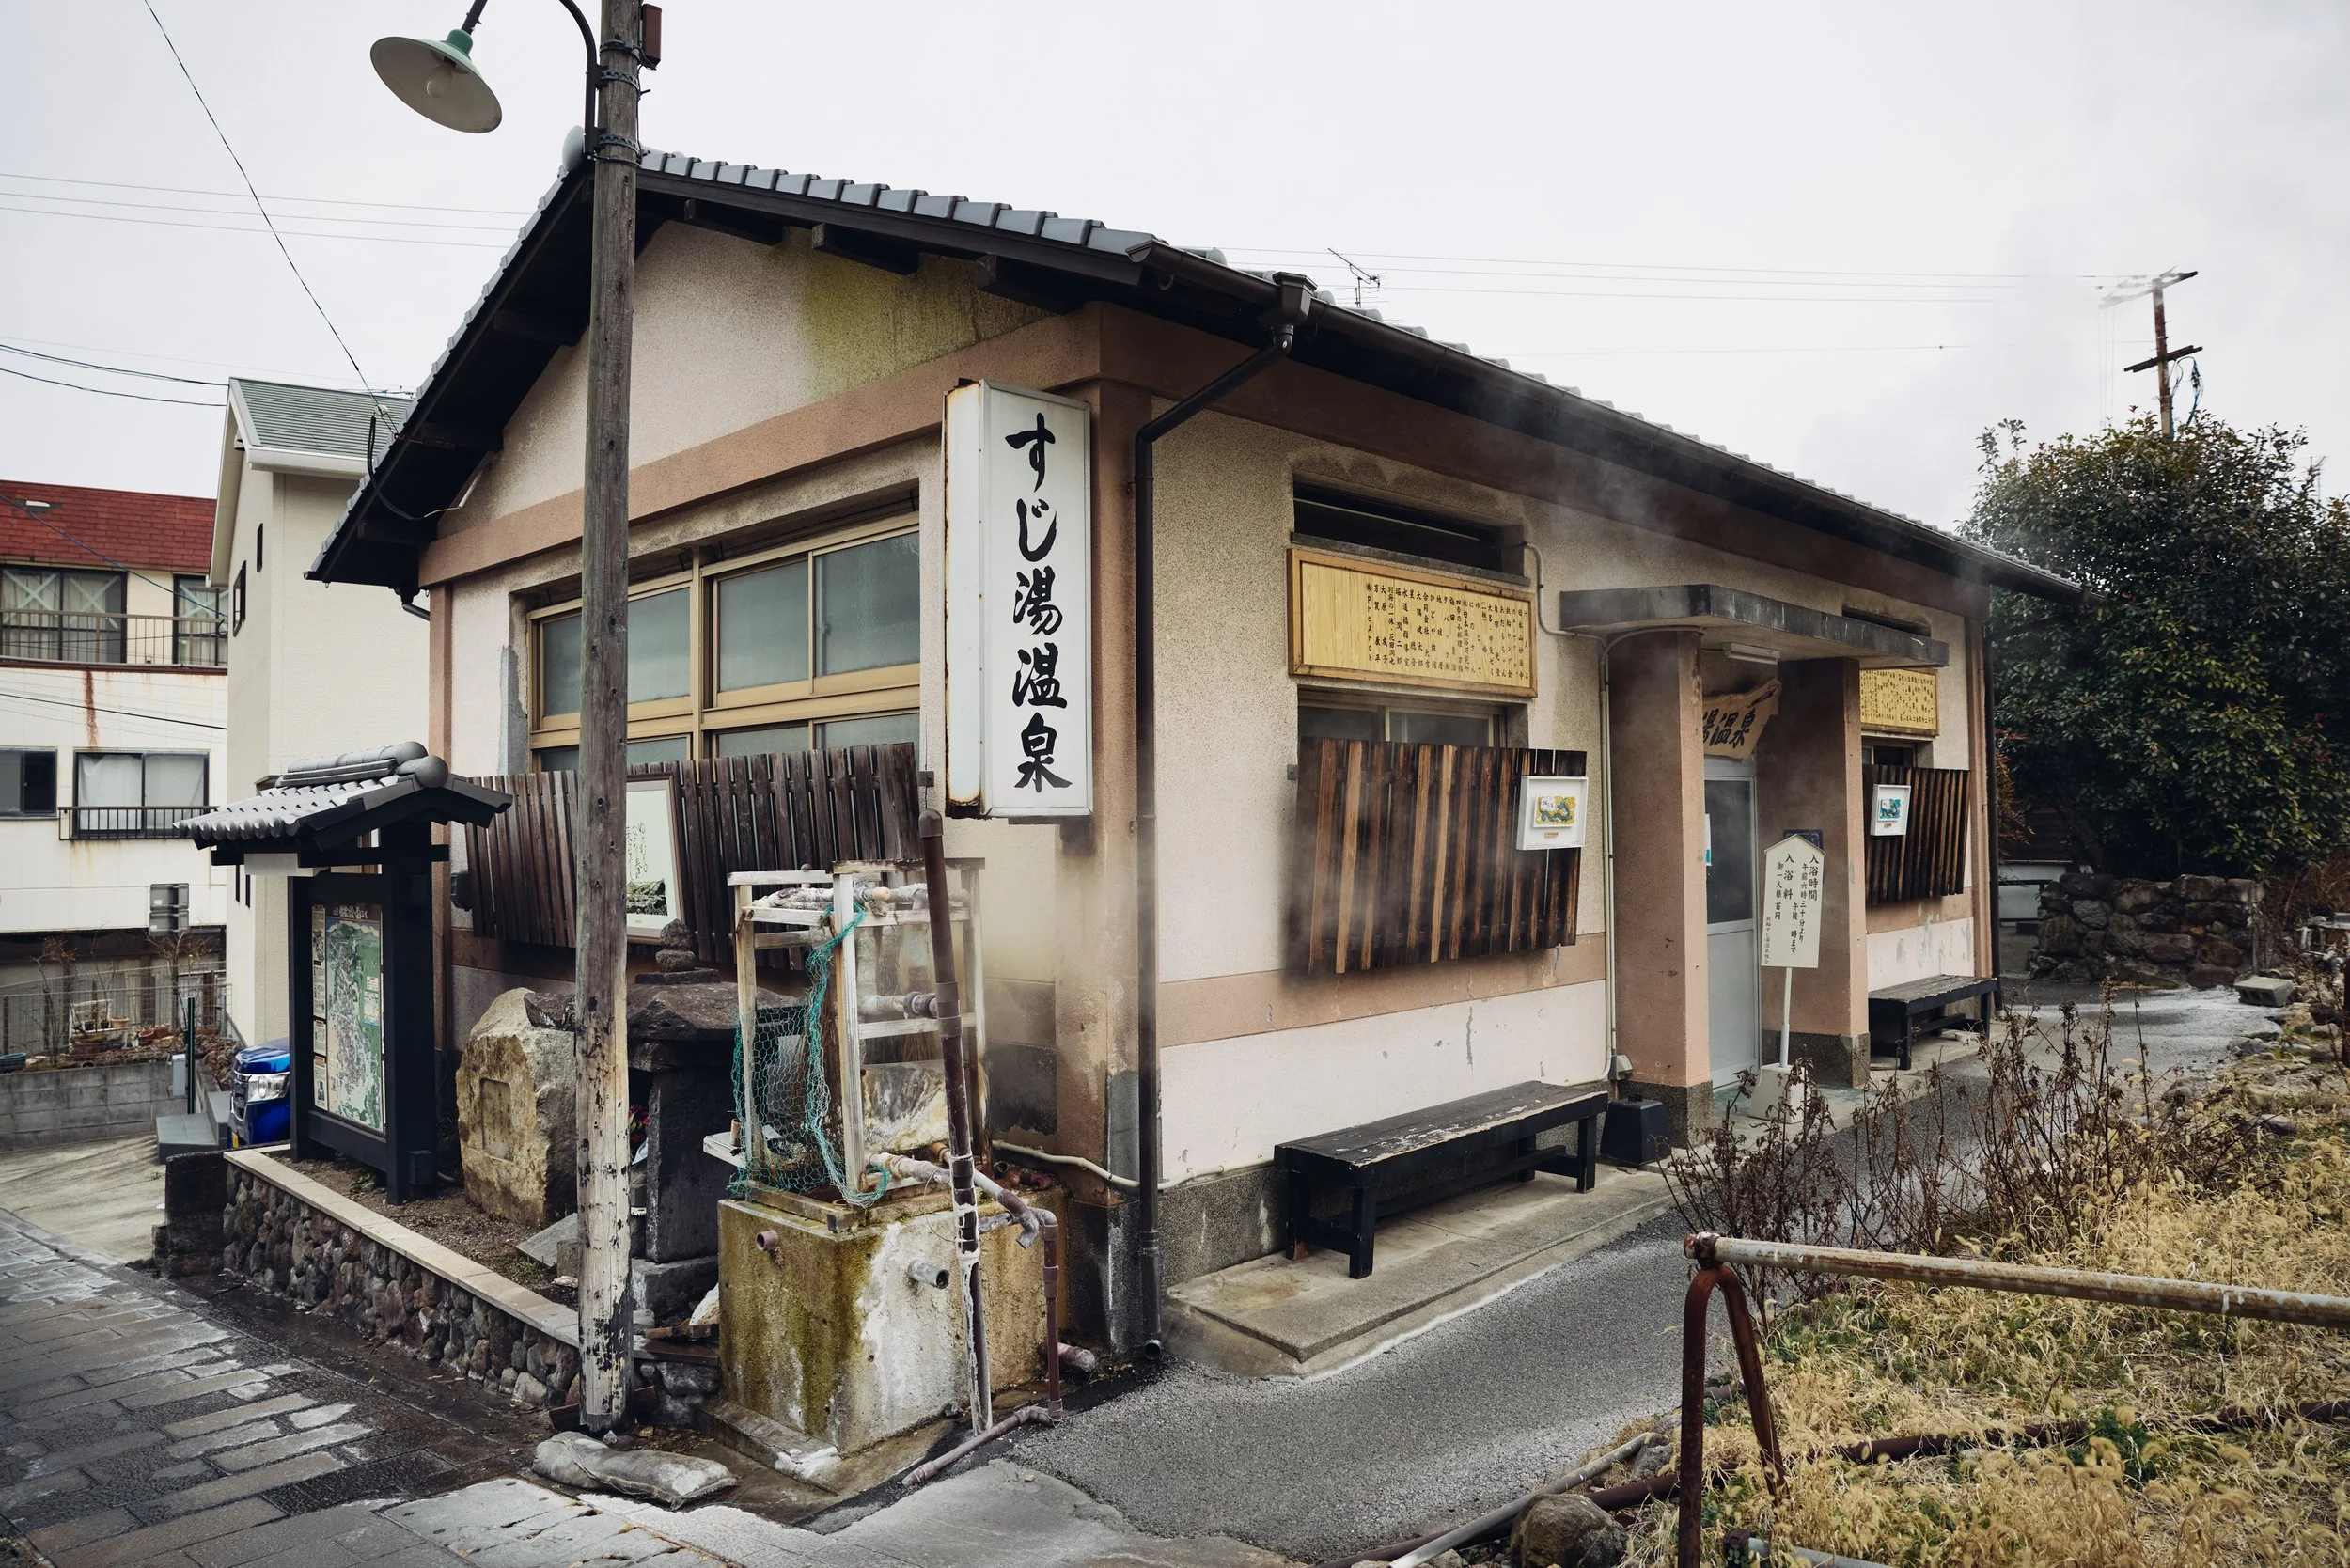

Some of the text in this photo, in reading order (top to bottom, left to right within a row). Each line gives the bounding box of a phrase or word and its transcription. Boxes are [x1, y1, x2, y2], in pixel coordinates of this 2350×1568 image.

[1005, 412, 1073, 793] すじ湯温泉
[1782, 853, 1794, 900] 入浴料
[1798, 862, 1809, 944] 午前六時三十分より
[1809, 854, 1820, 902] 入浴時間
